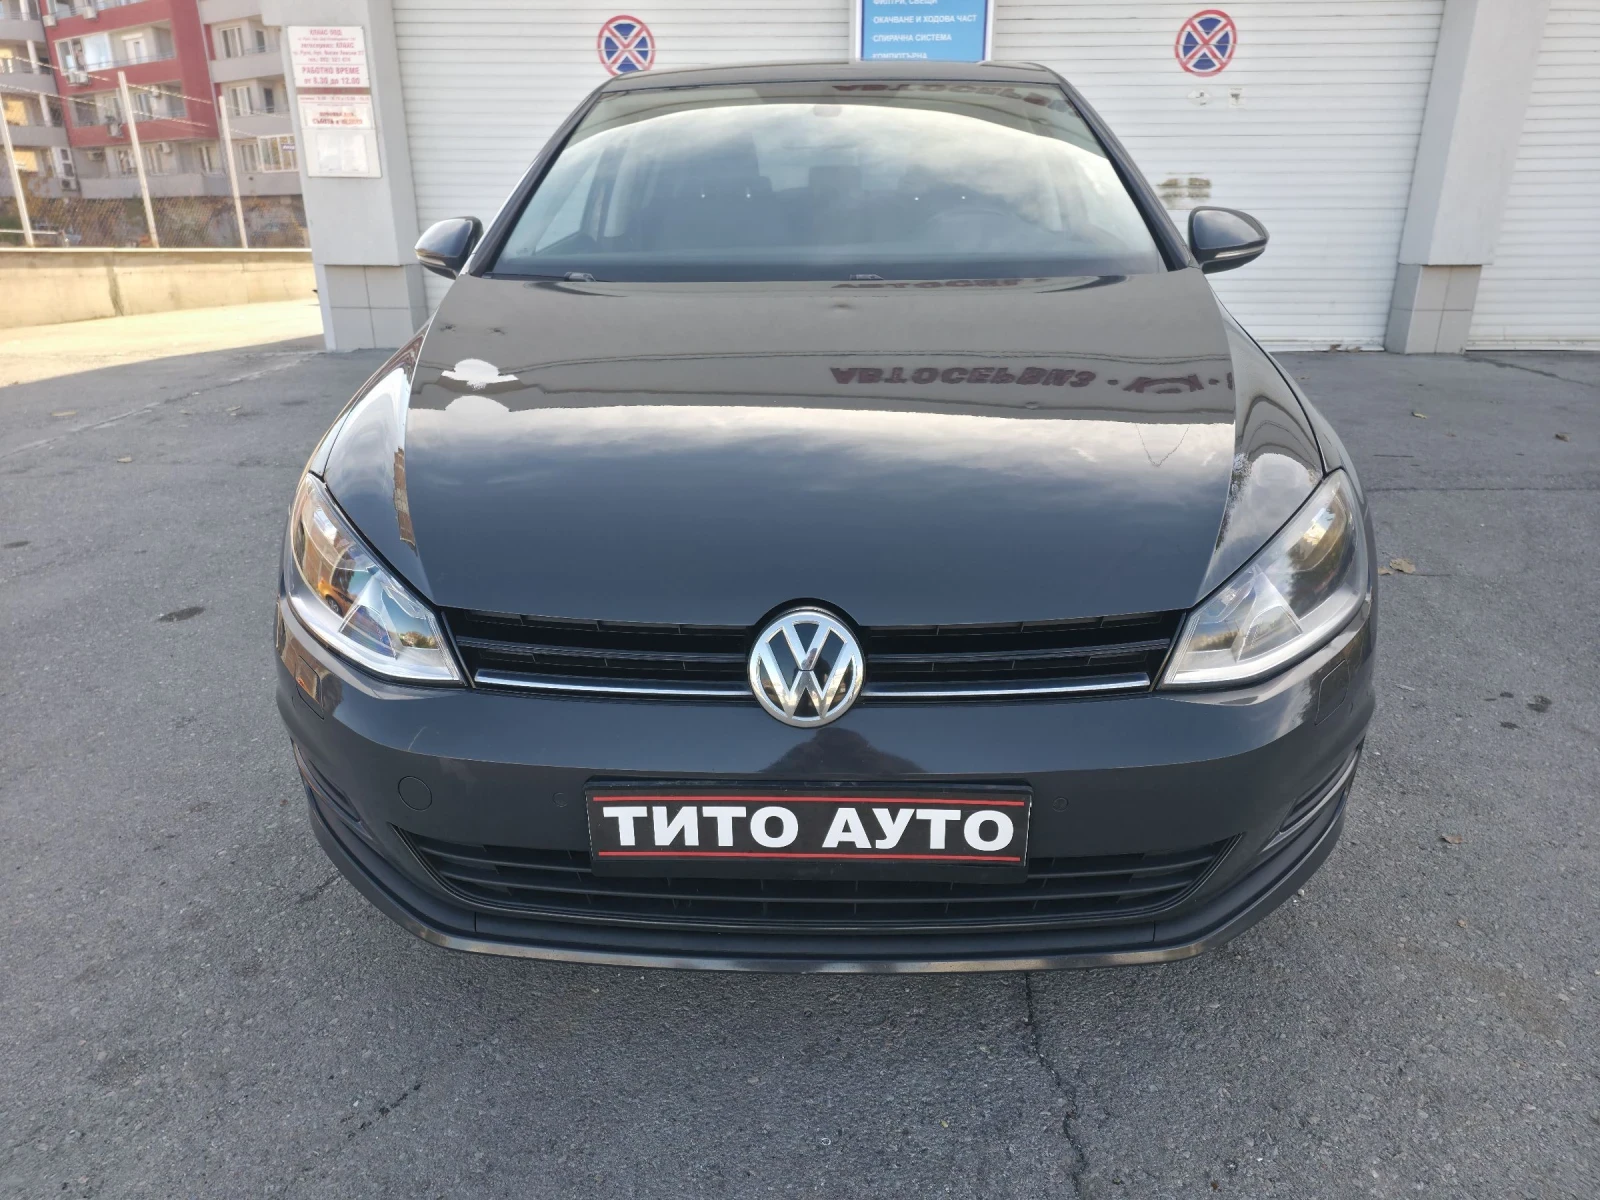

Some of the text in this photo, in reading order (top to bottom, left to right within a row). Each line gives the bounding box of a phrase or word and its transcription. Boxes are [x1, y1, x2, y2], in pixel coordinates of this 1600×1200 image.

[873, 14, 977, 24] ОКАЧВАНЕ И ХОДОВА ЧАСТ
[872, 33, 952, 42] СПИРАЧНА СИСТЕМА
[301, 66, 360, 74] РАБОТНО ВРЕМЕ
[603, 805, 1014, 852] ТИТО АУТО
